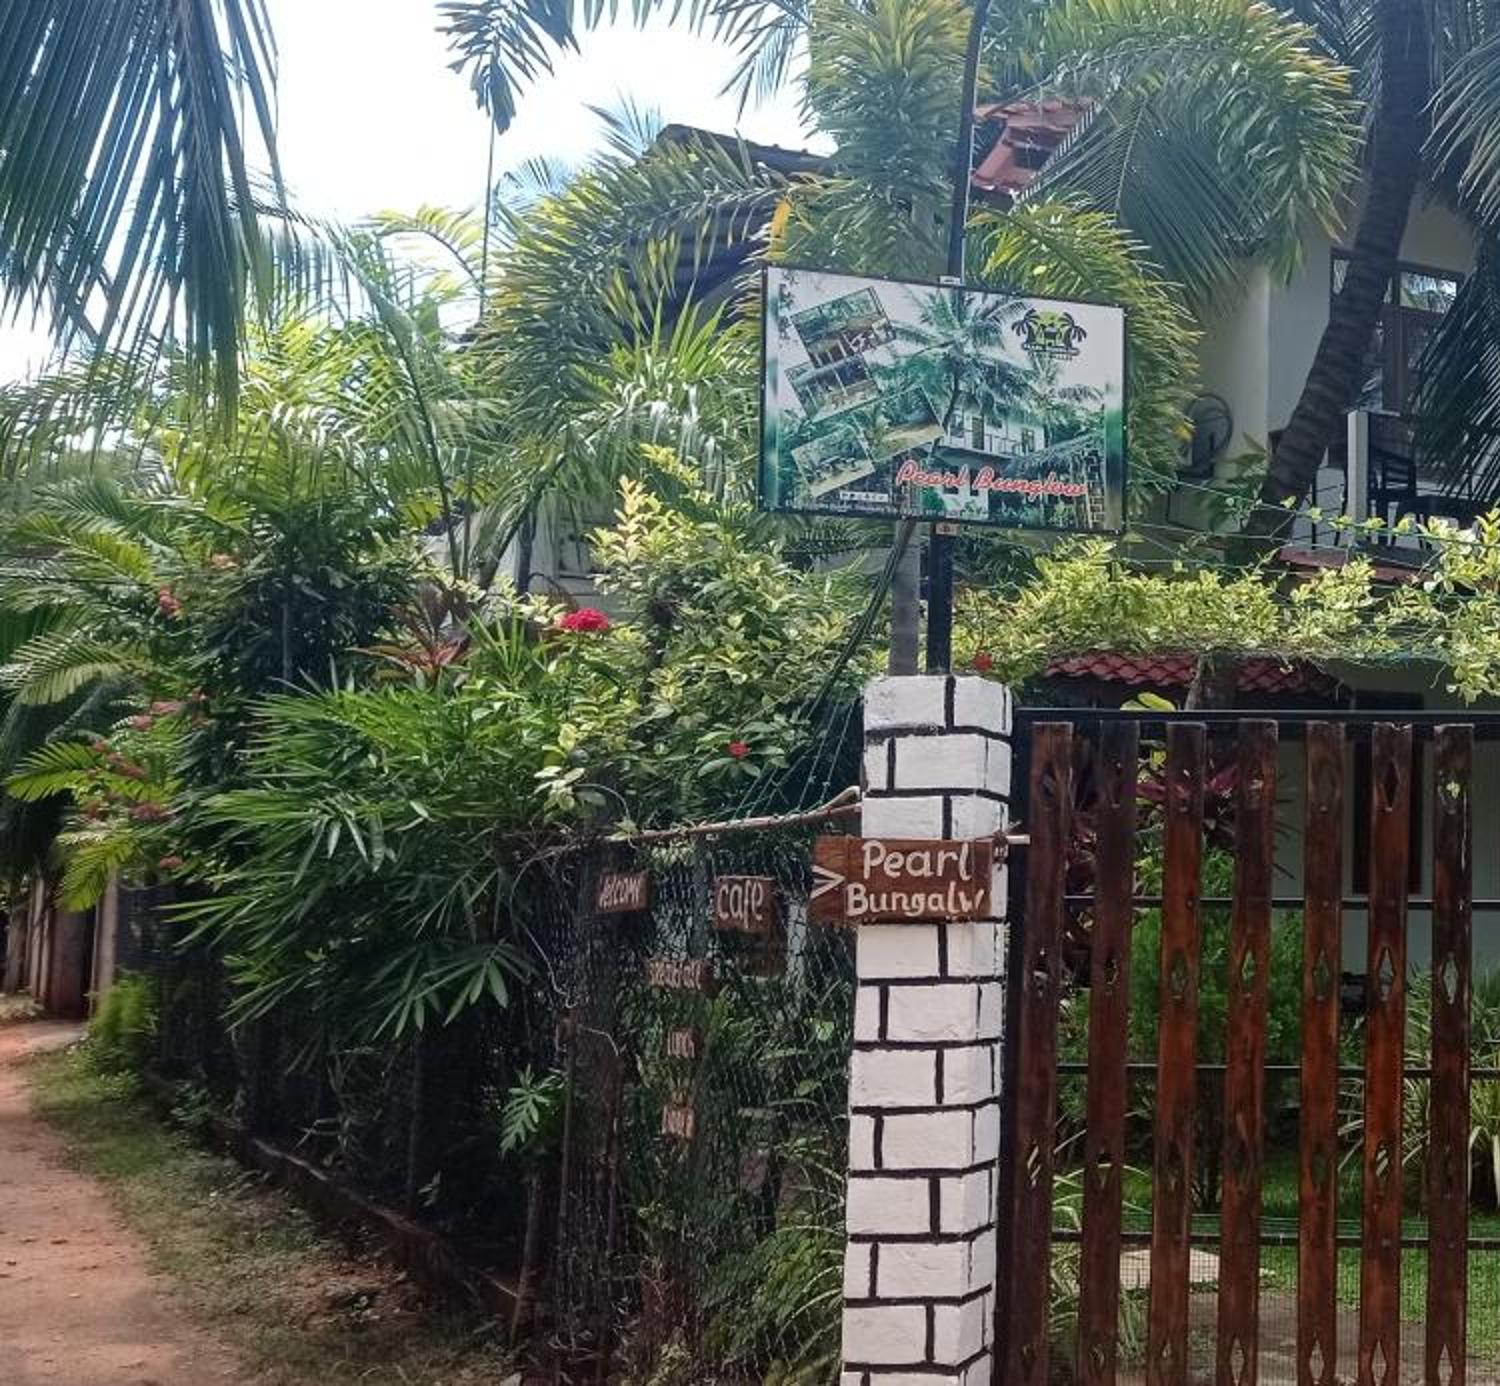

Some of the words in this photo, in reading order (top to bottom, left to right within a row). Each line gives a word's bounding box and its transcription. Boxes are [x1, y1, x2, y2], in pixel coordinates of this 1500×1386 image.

[896, 459, 971, 487] Pearl
[861, 840, 972, 881] Pearl
[717, 879, 763, 928] cafe
